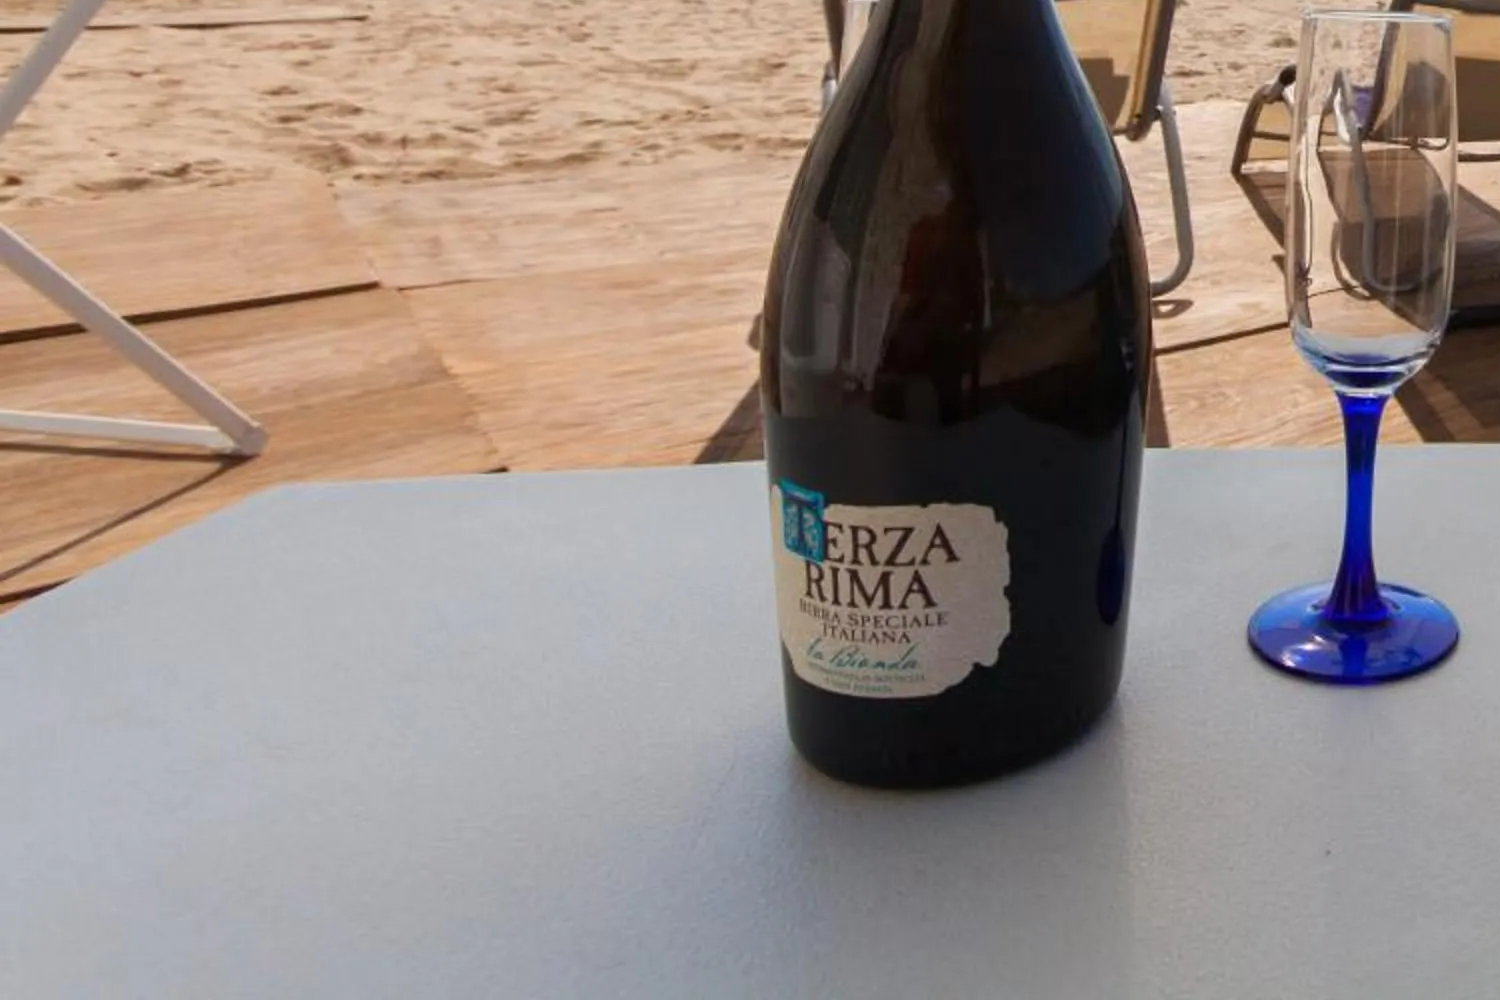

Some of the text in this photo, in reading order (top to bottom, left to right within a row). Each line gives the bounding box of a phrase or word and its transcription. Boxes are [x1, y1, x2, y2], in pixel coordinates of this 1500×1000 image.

[780, 484, 961, 567] TERZA
[804, 559, 938, 610] RIMA
[822, 622, 912, 645] ITALIANA
[849, 610, 949, 630] SPECIALE
